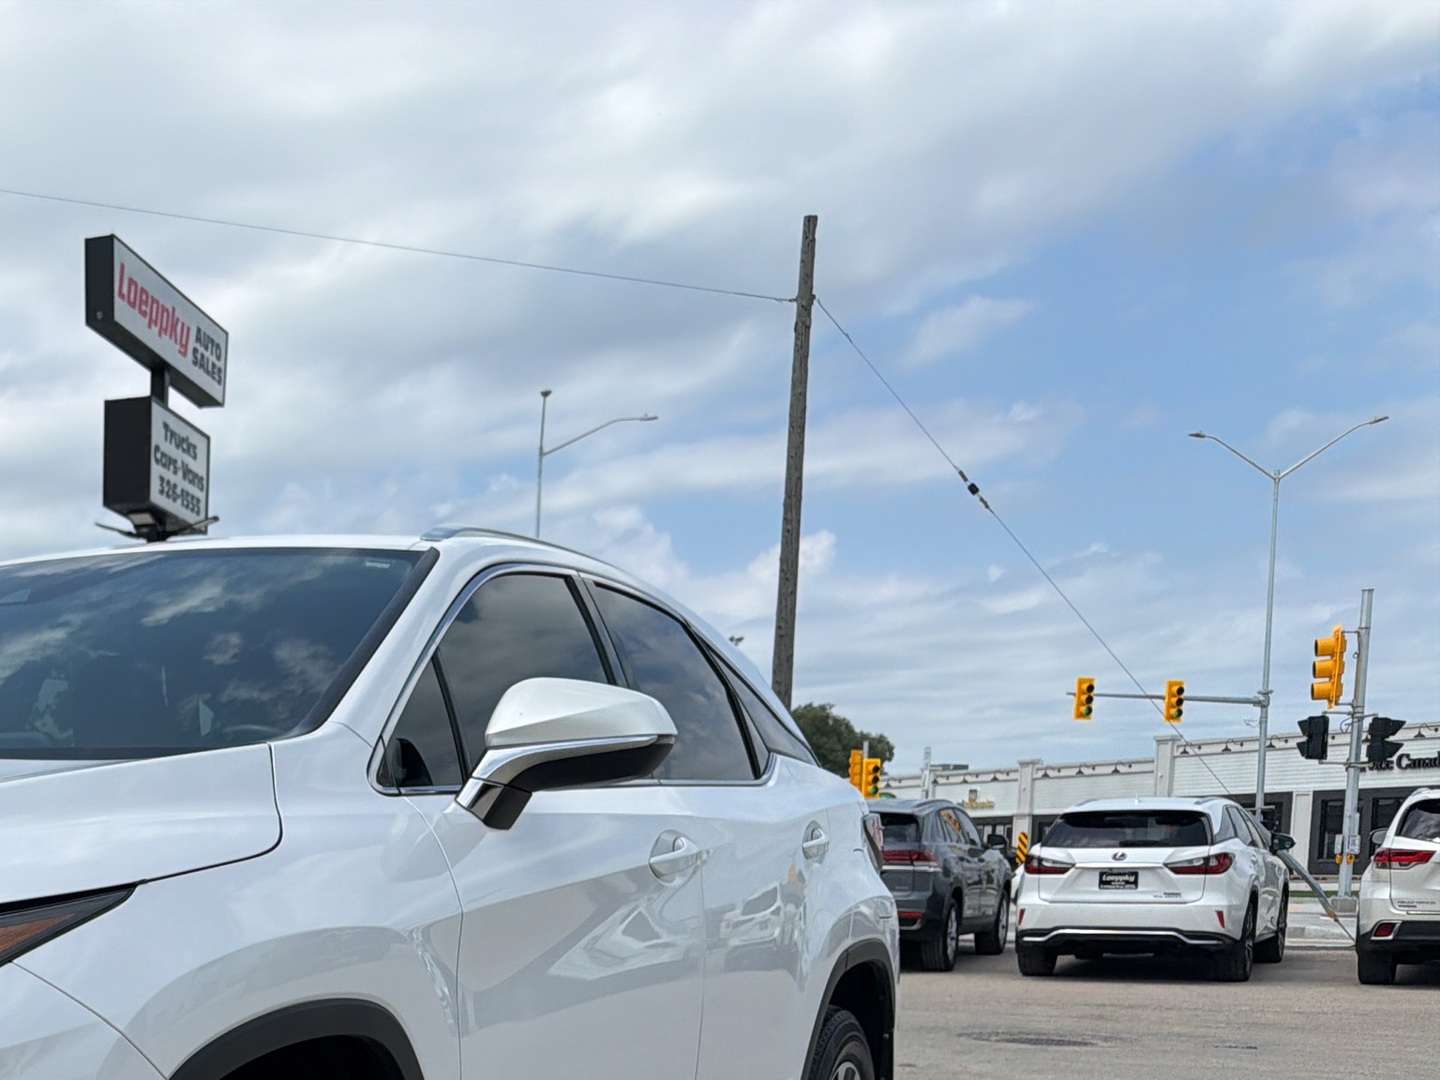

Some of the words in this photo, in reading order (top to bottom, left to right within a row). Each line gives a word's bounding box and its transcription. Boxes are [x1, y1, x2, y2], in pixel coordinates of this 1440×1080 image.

[117, 261, 191, 358] Loeppky
[194, 325, 223, 361] AUTO
[192, 346, 223, 386] SALES
[162, 421, 198, 461] Trucks
